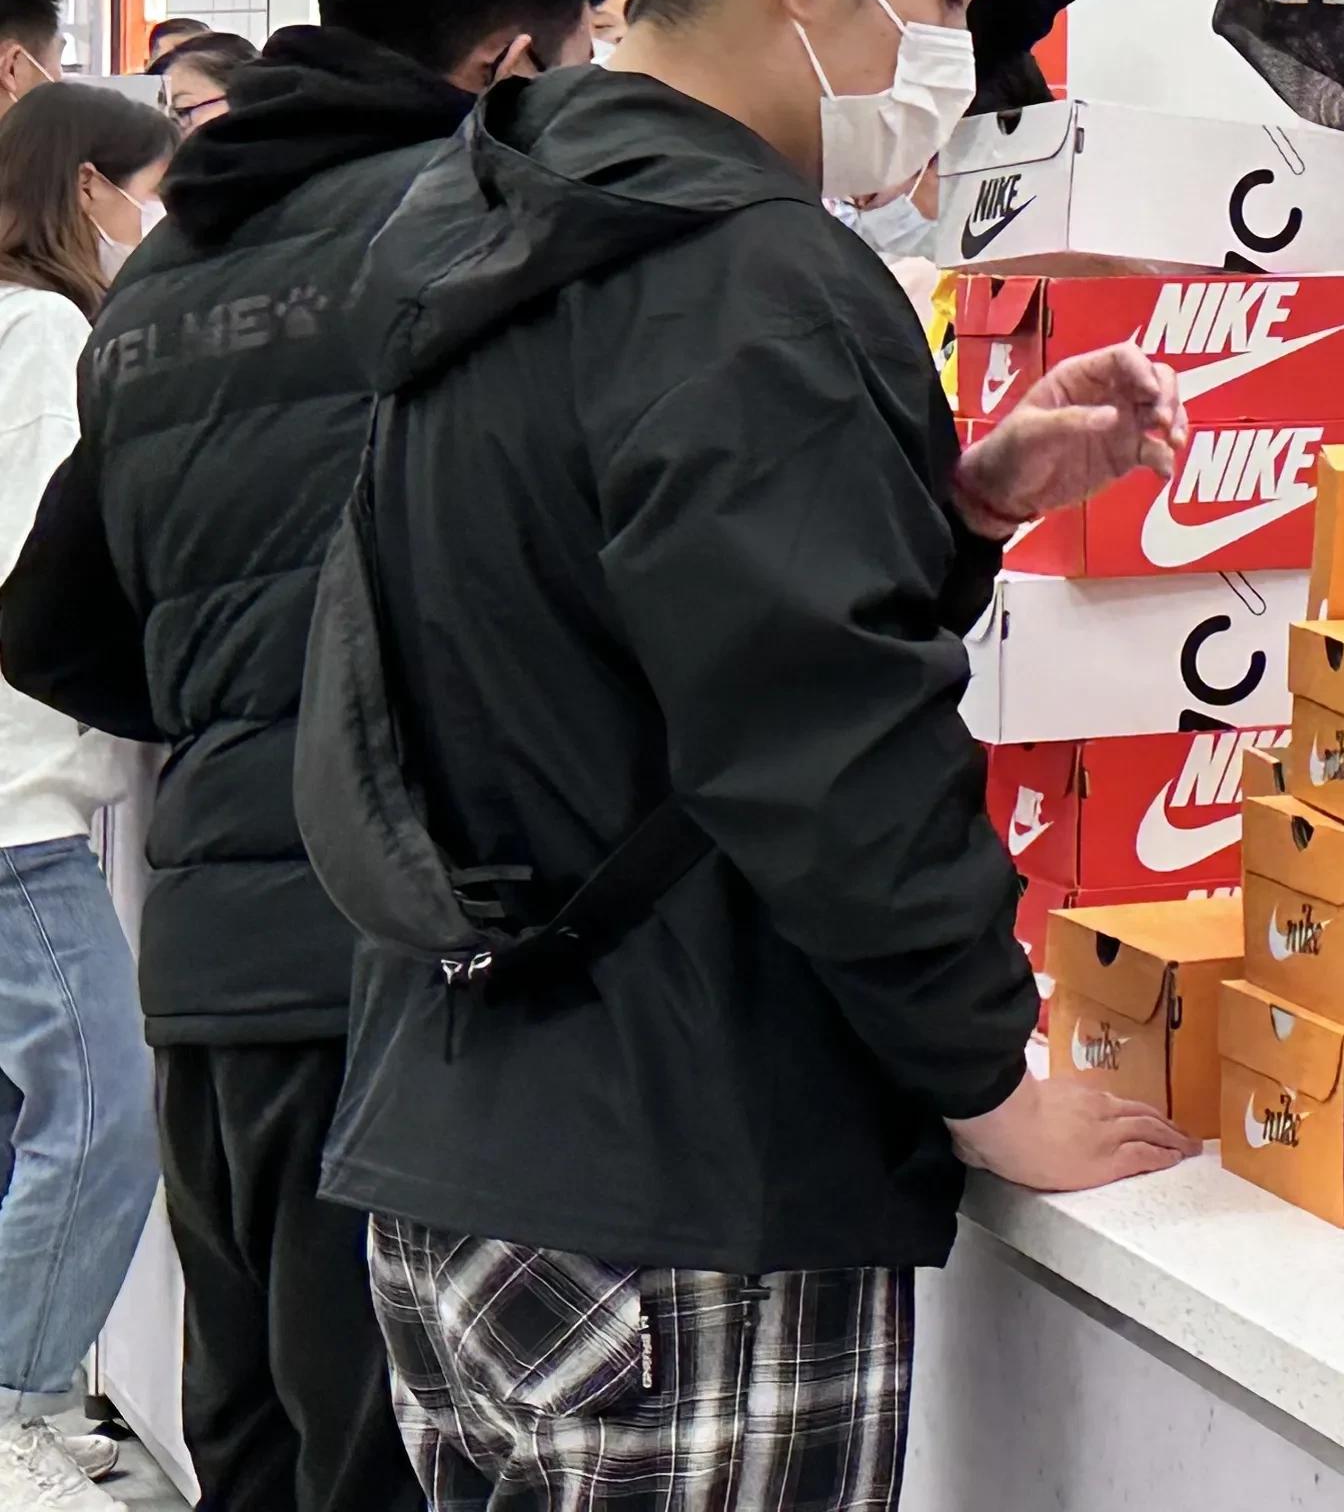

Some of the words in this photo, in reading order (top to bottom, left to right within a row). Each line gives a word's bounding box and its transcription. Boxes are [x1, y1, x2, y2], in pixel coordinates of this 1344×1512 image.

[972, 173, 1023, 223] NIKE
[1142, 280, 1300, 356] NIKE
[1173, 427, 1324, 505] NIKE
